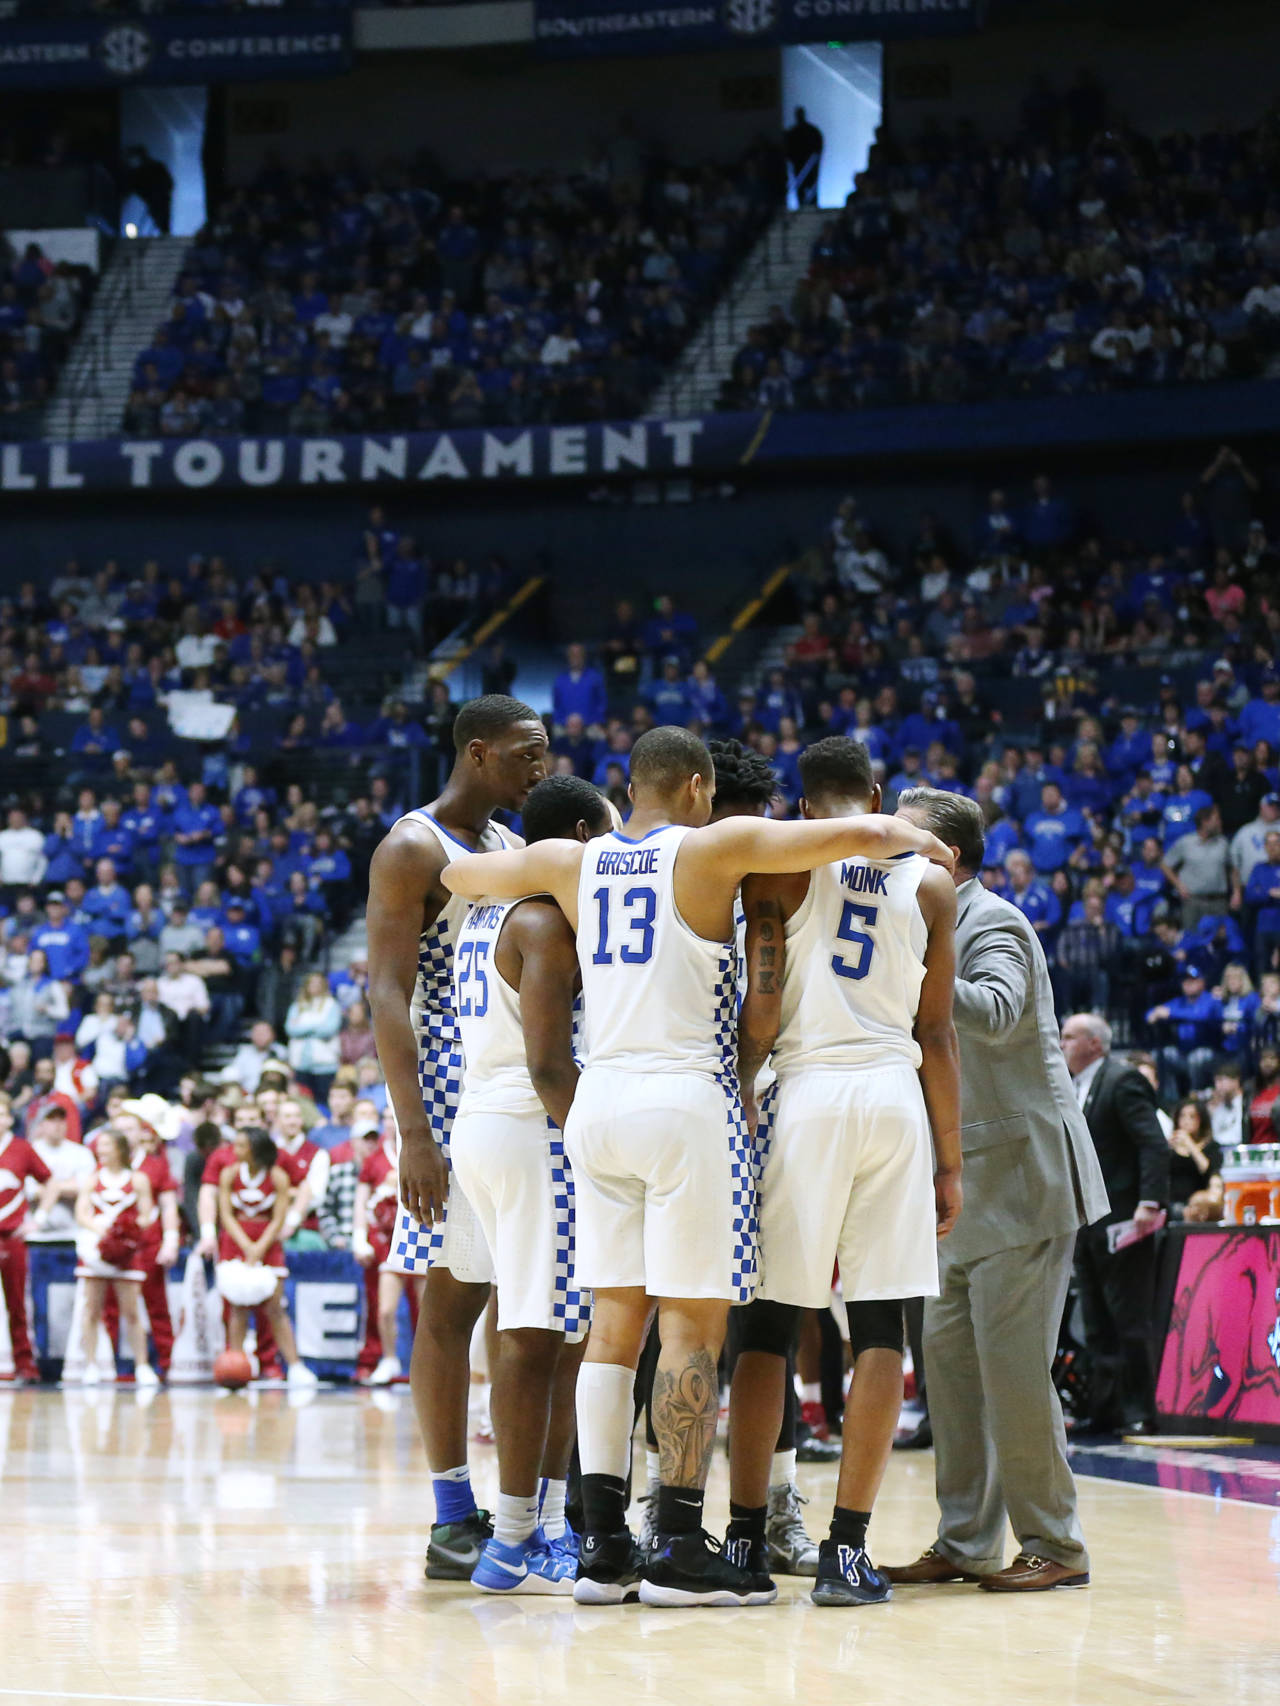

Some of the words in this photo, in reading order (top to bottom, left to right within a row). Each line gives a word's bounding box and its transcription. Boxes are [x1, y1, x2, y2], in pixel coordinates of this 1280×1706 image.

[167, 33, 343, 59] CONFERENCE
[120, 419, 703, 488] TOURNAMENT
[595, 848, 661, 876] BRISCOE
[840, 861, 891, 897] MONK
[592, 886, 657, 965] 13
[831, 899, 879, 981] 5
[458, 941, 490, 1018] 25
